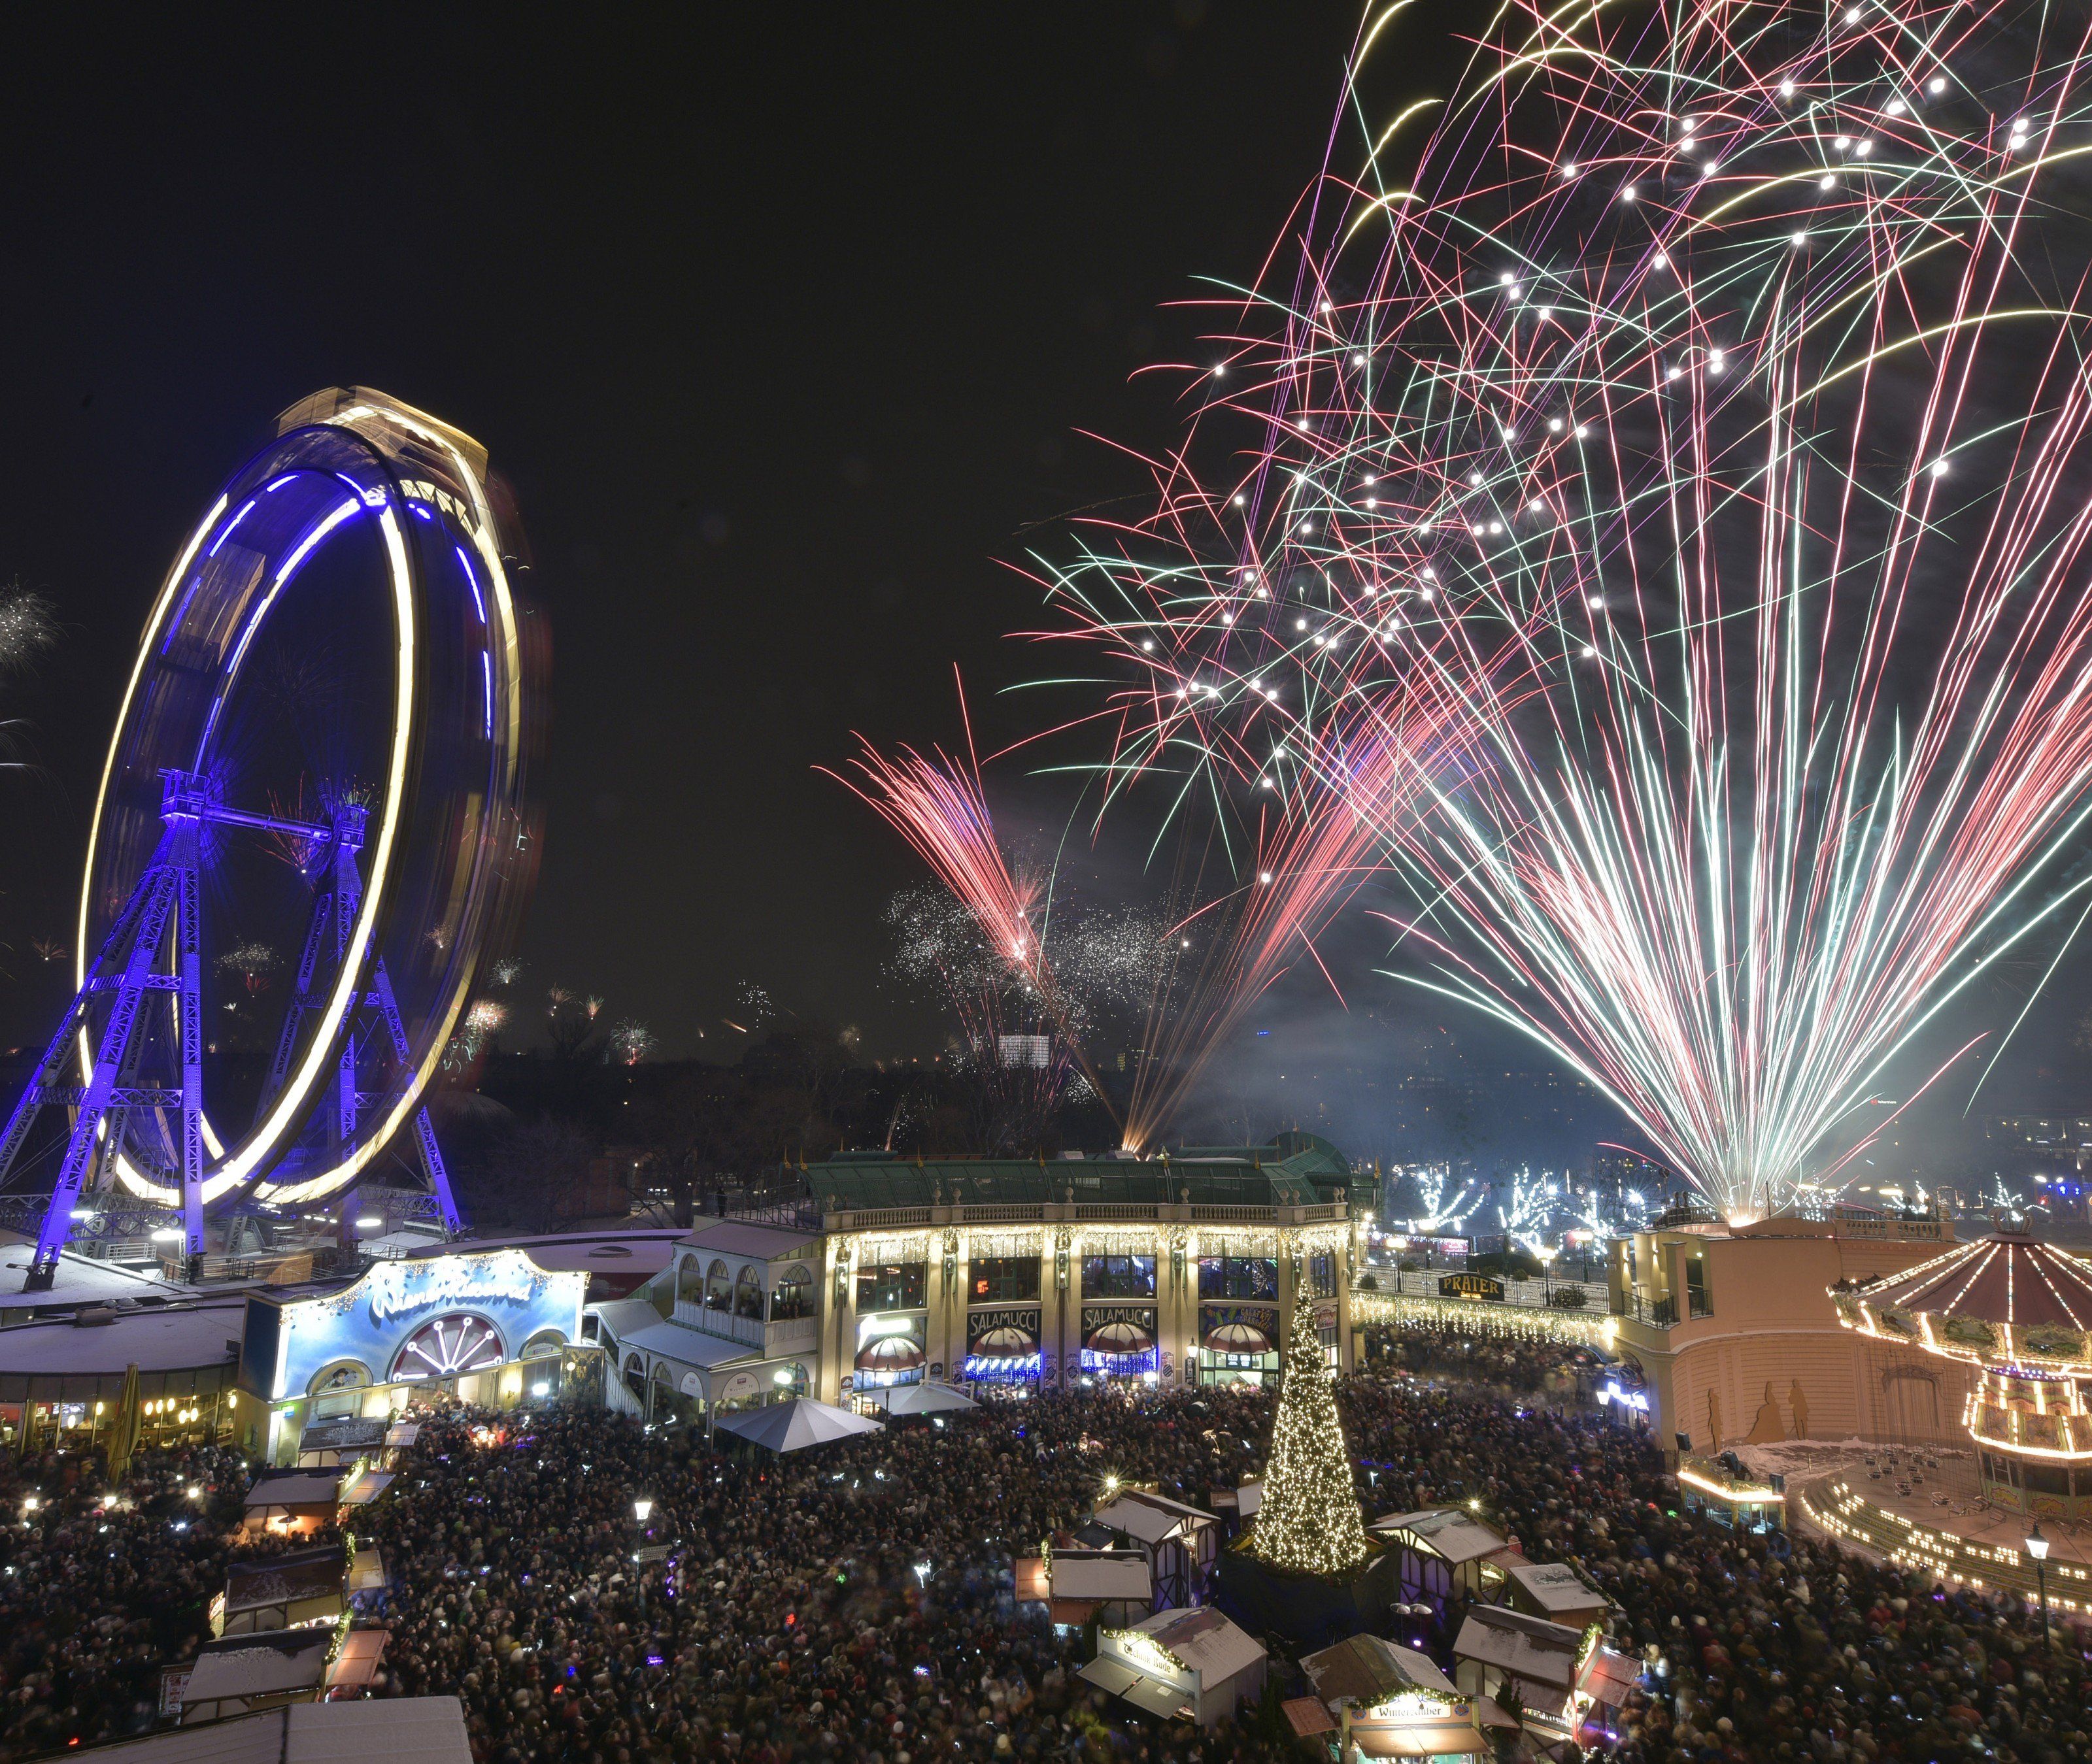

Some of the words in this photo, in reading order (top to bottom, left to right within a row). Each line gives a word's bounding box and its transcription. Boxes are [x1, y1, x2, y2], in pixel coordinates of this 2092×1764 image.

[1443, 1275, 1499, 1293] PRATER
[970, 1308, 1038, 1337] SALAMUCCI
[1084, 1308, 1155, 1331] SALAMUCCI
